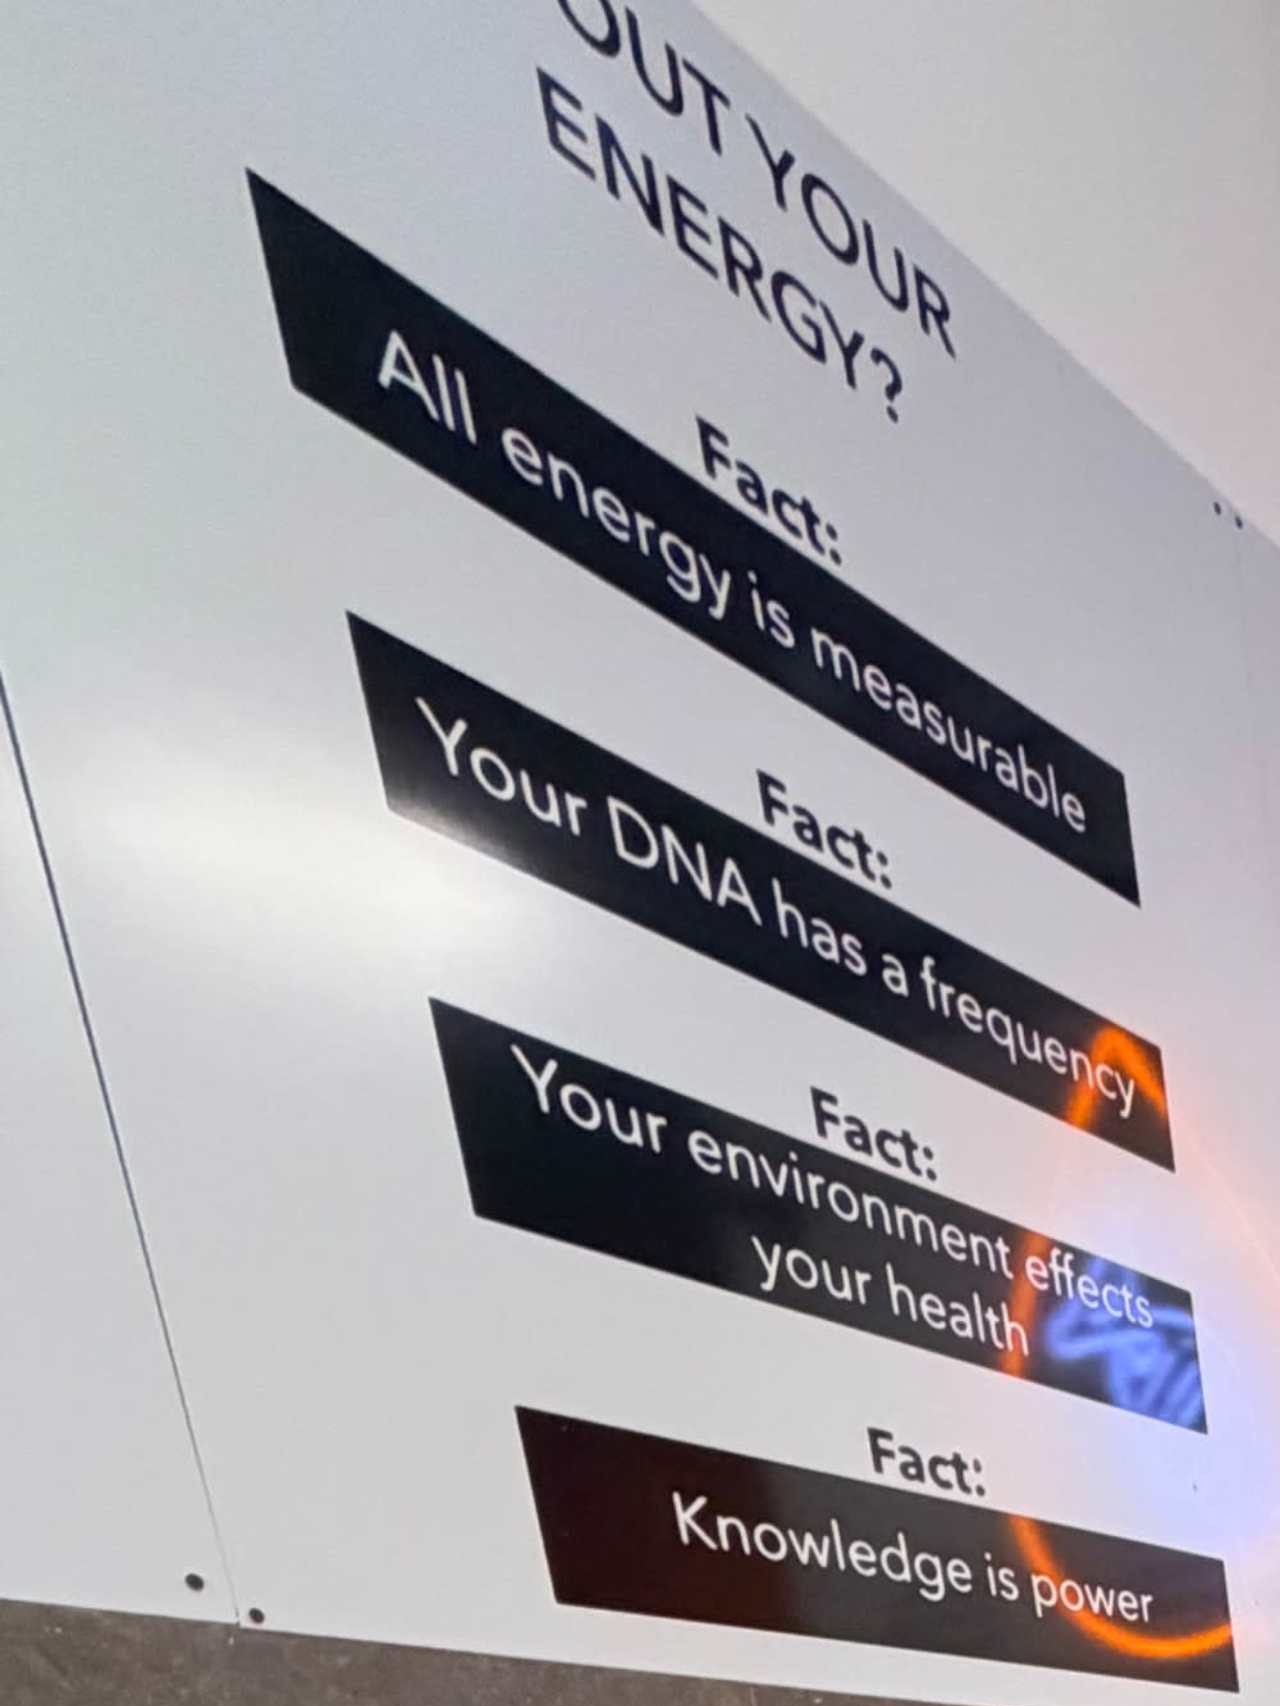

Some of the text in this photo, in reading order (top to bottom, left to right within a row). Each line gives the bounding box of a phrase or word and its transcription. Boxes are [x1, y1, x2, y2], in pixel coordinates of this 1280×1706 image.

[536, 65, 904, 422] ENERGY?
[745, 112, 957, 360] YOUR
[695, 411, 844, 567] Fact:
[377, 330, 1087, 836] All energy is measurable
[757, 769, 894, 890] Fact:
[415, 697, 1138, 1119] Your DNA has a frequency
[512, 1043, 1154, 1330] Your environment effects
[810, 1086, 940, 1182] Fact:
[751, 1235, 1030, 1358] your health
[867, 1427, 987, 1498] Fact:
[672, 1492, 1154, 1627] Knowledge is power
